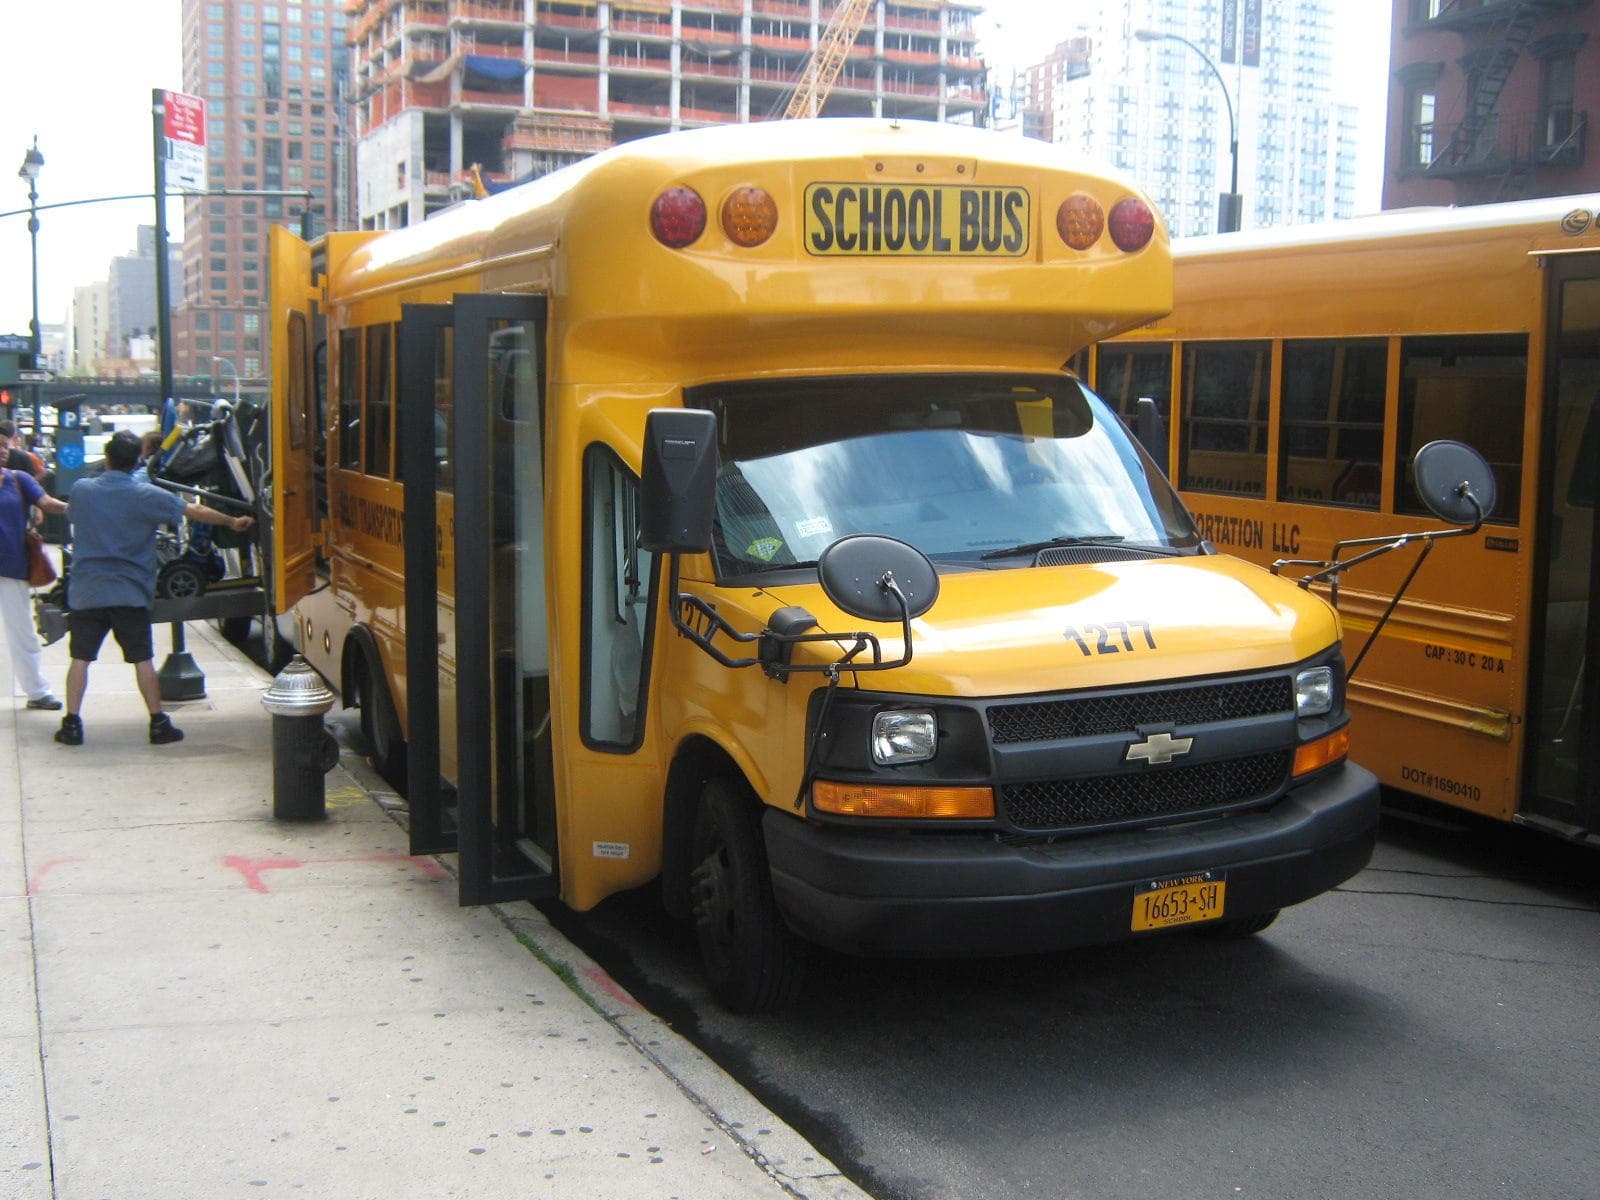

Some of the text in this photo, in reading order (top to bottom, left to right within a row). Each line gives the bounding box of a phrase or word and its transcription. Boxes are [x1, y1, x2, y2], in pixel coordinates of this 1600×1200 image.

[811, 187, 1023, 253] SCHOOL BUS
[64, 411, 77, 428] P
[1272, 522, 1300, 555] LLC
[1063, 620, 1157, 656] 1277
[1425, 644, 1445, 660] CAP
[1454, 650, 1465, 665] 30
[1469, 653, 1475, 667] C
[1482, 656, 1494, 671] 20
[1497, 659, 1504, 673] A
[1402, 766, 1480, 801] DOT#1690410
[1158, 875, 1203, 889] NEW YORK
